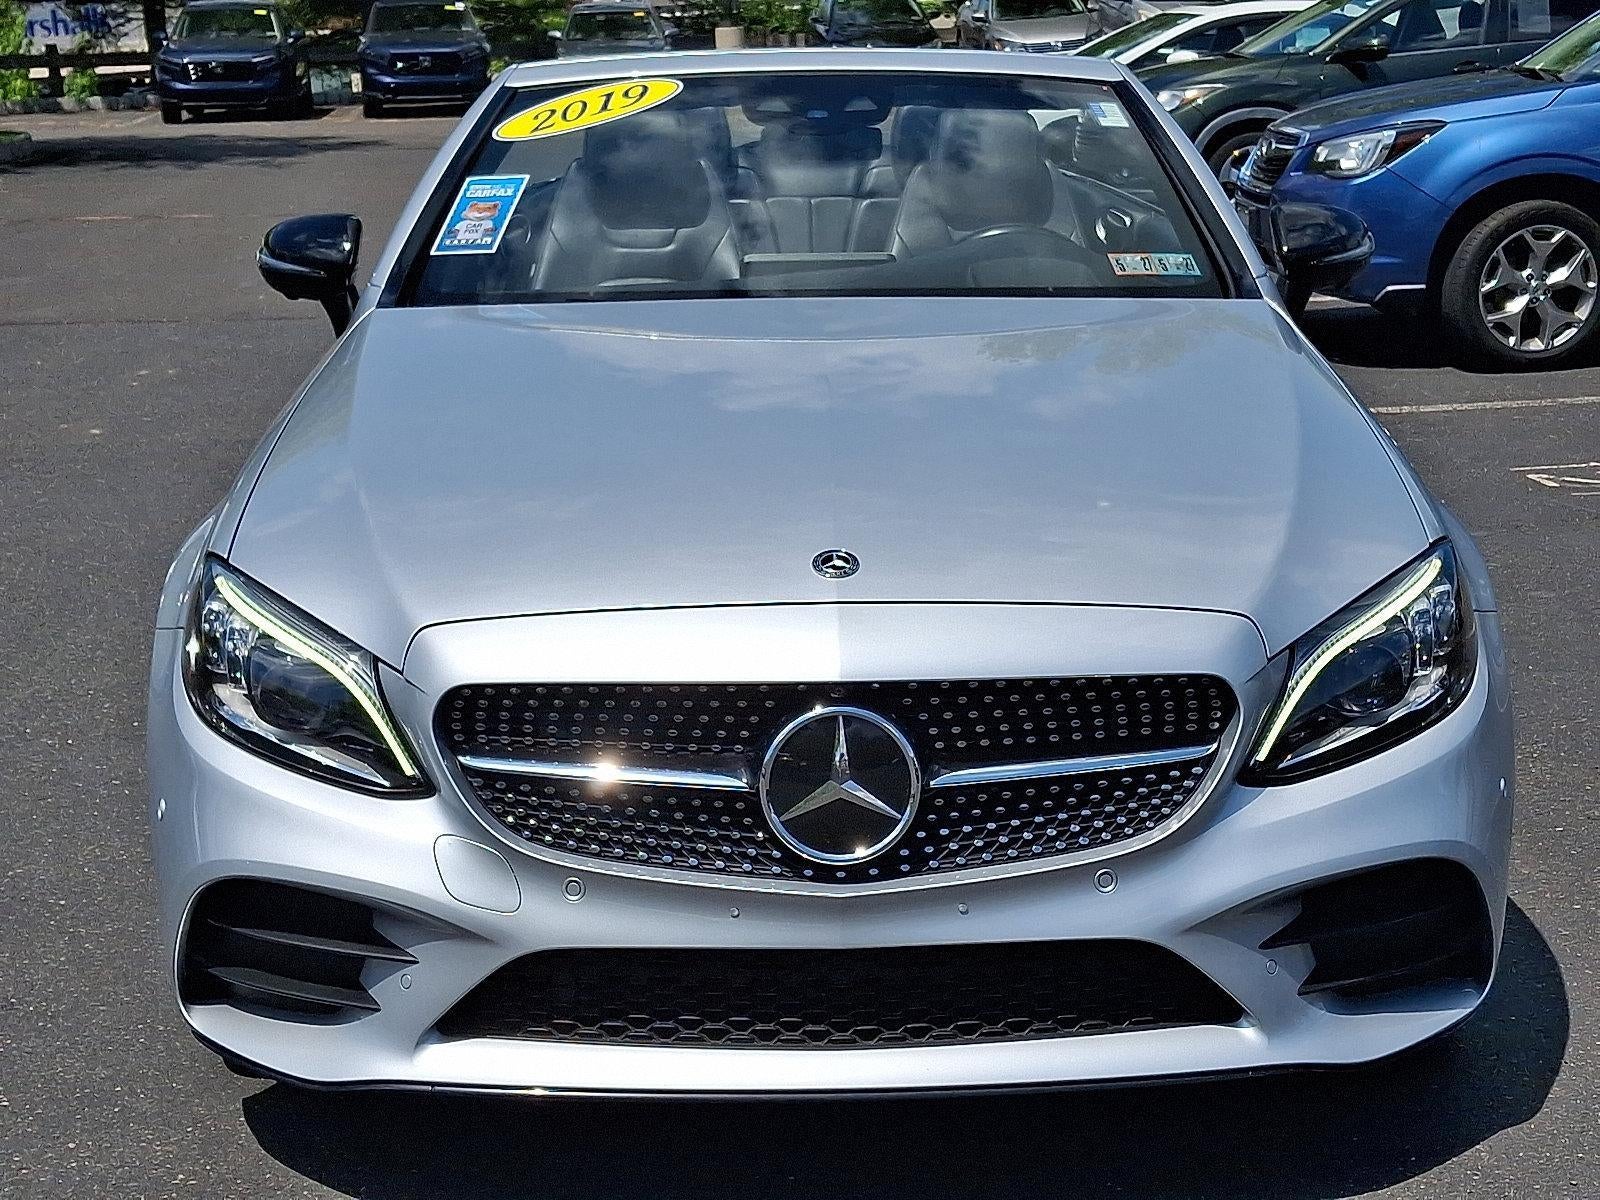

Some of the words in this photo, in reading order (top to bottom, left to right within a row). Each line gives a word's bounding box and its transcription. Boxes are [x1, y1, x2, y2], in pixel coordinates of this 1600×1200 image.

[529, 84, 649, 134] 2019
[466, 187, 515, 198] CARFAX
[1115, 257, 1127, 272] 5
[1157, 258, 1169, 272] 5
